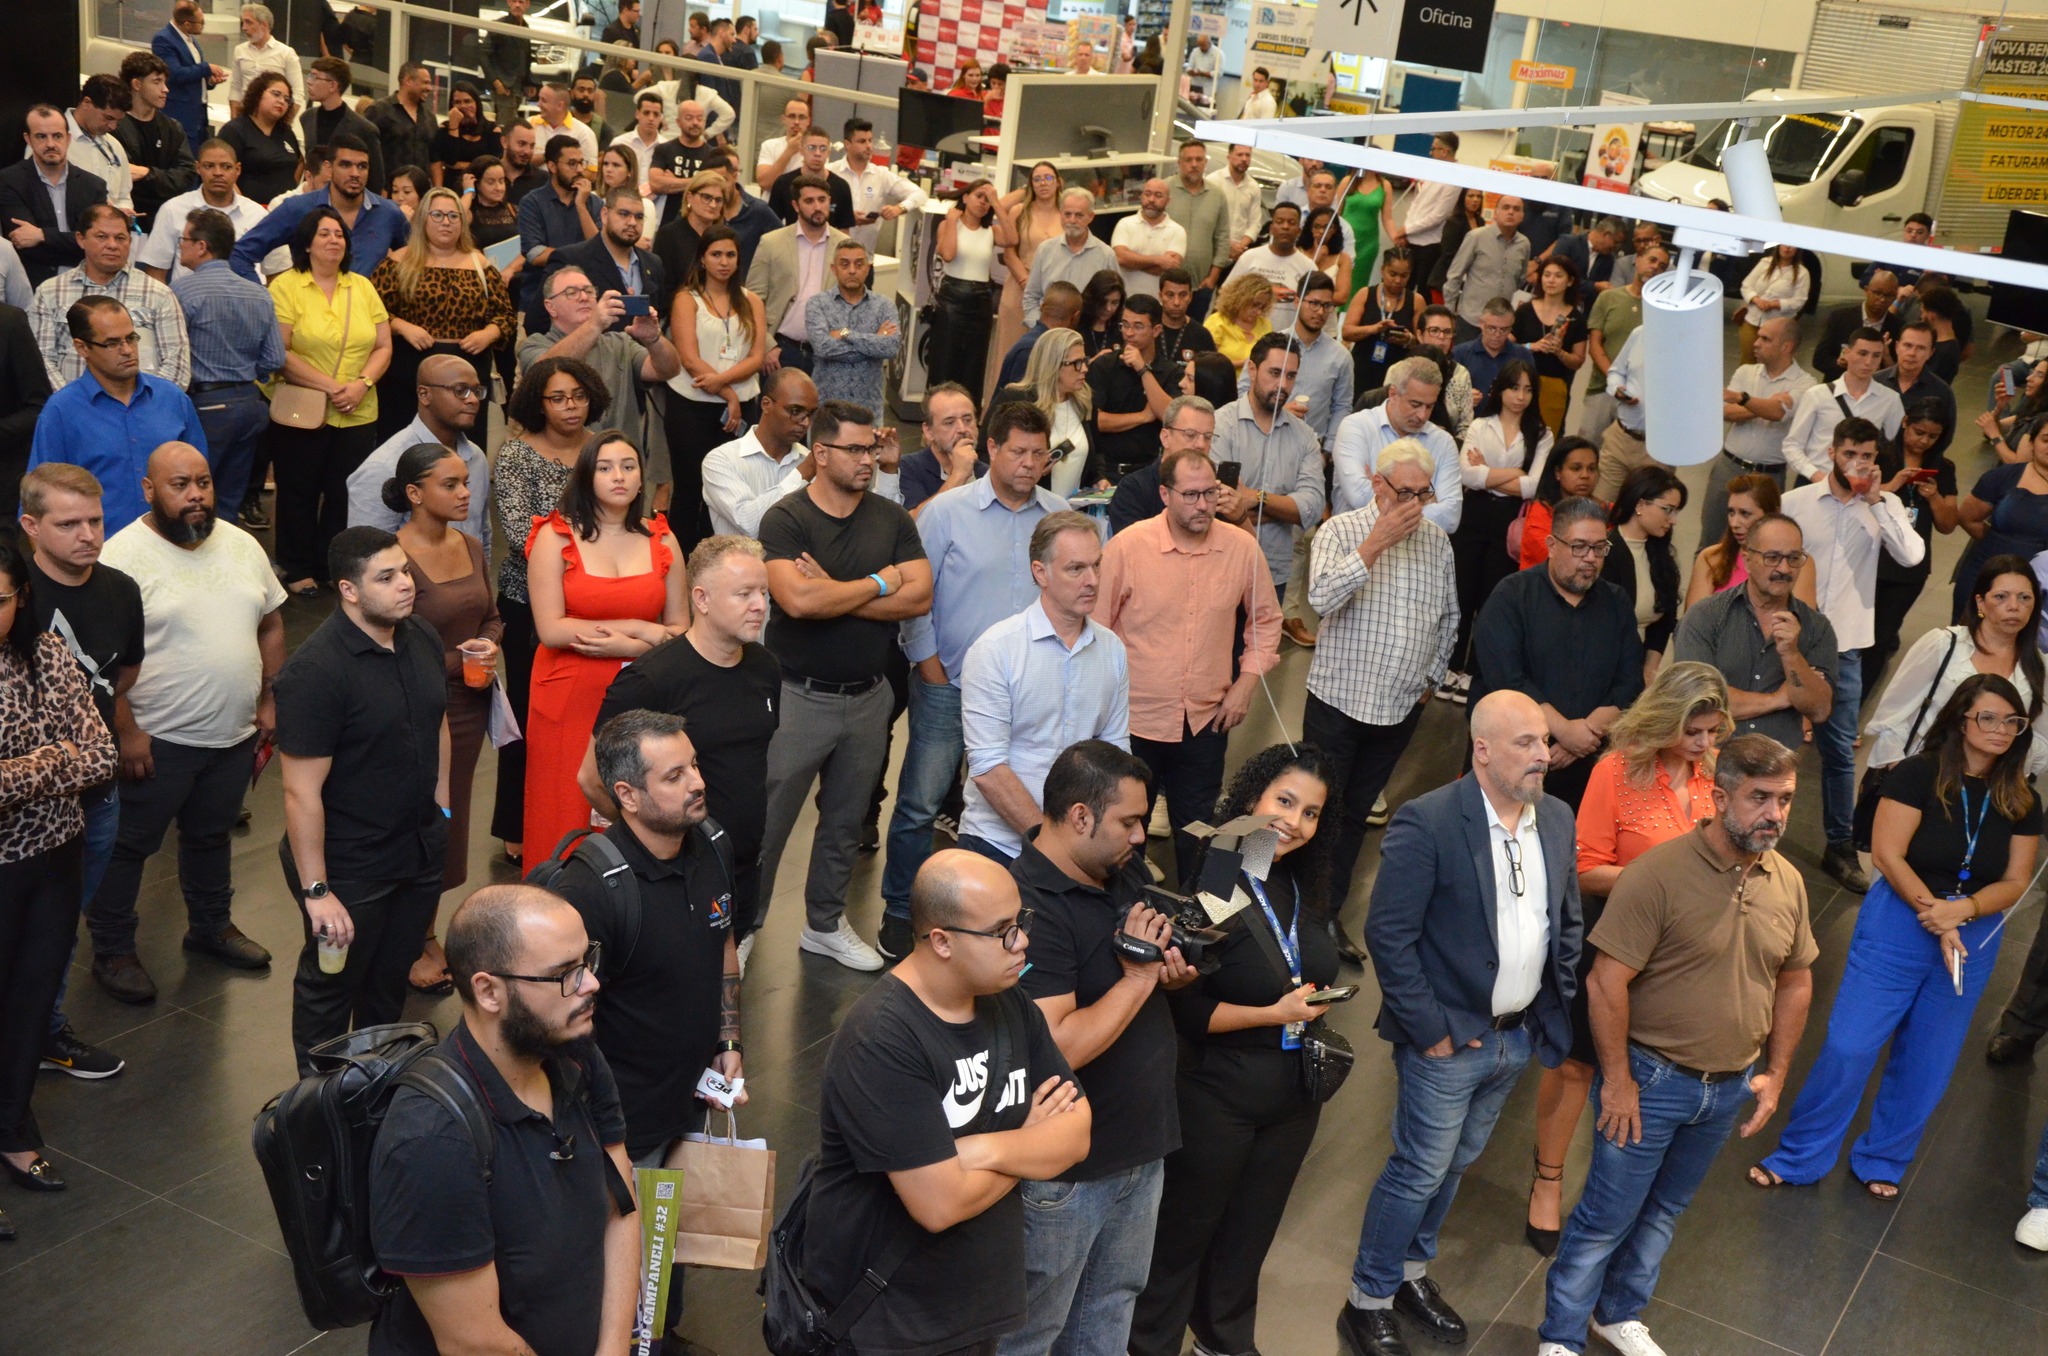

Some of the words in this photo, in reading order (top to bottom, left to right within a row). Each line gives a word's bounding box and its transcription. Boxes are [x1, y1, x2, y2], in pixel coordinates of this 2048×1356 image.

[1419, 7, 1473, 29] Oficina
[1257, 32, 1279, 41] CURSOS
[1280, 35, 1308, 45] TÉCNICOS
[1993, 41, 2025, 55] NOVA
[1518, 65, 1567, 80] Maximus
[1987, 59, 2037, 74] MASTER
[1988, 125, 2034, 138] MOTOR
[1987, 184, 2023, 200] LÍDER
[2024, 188, 2041, 200] DE
[1123, 943, 1145, 954] Canon
[643, 1235, 664, 1325] CAMPANELI
[655, 1205, 668, 1232] #32
